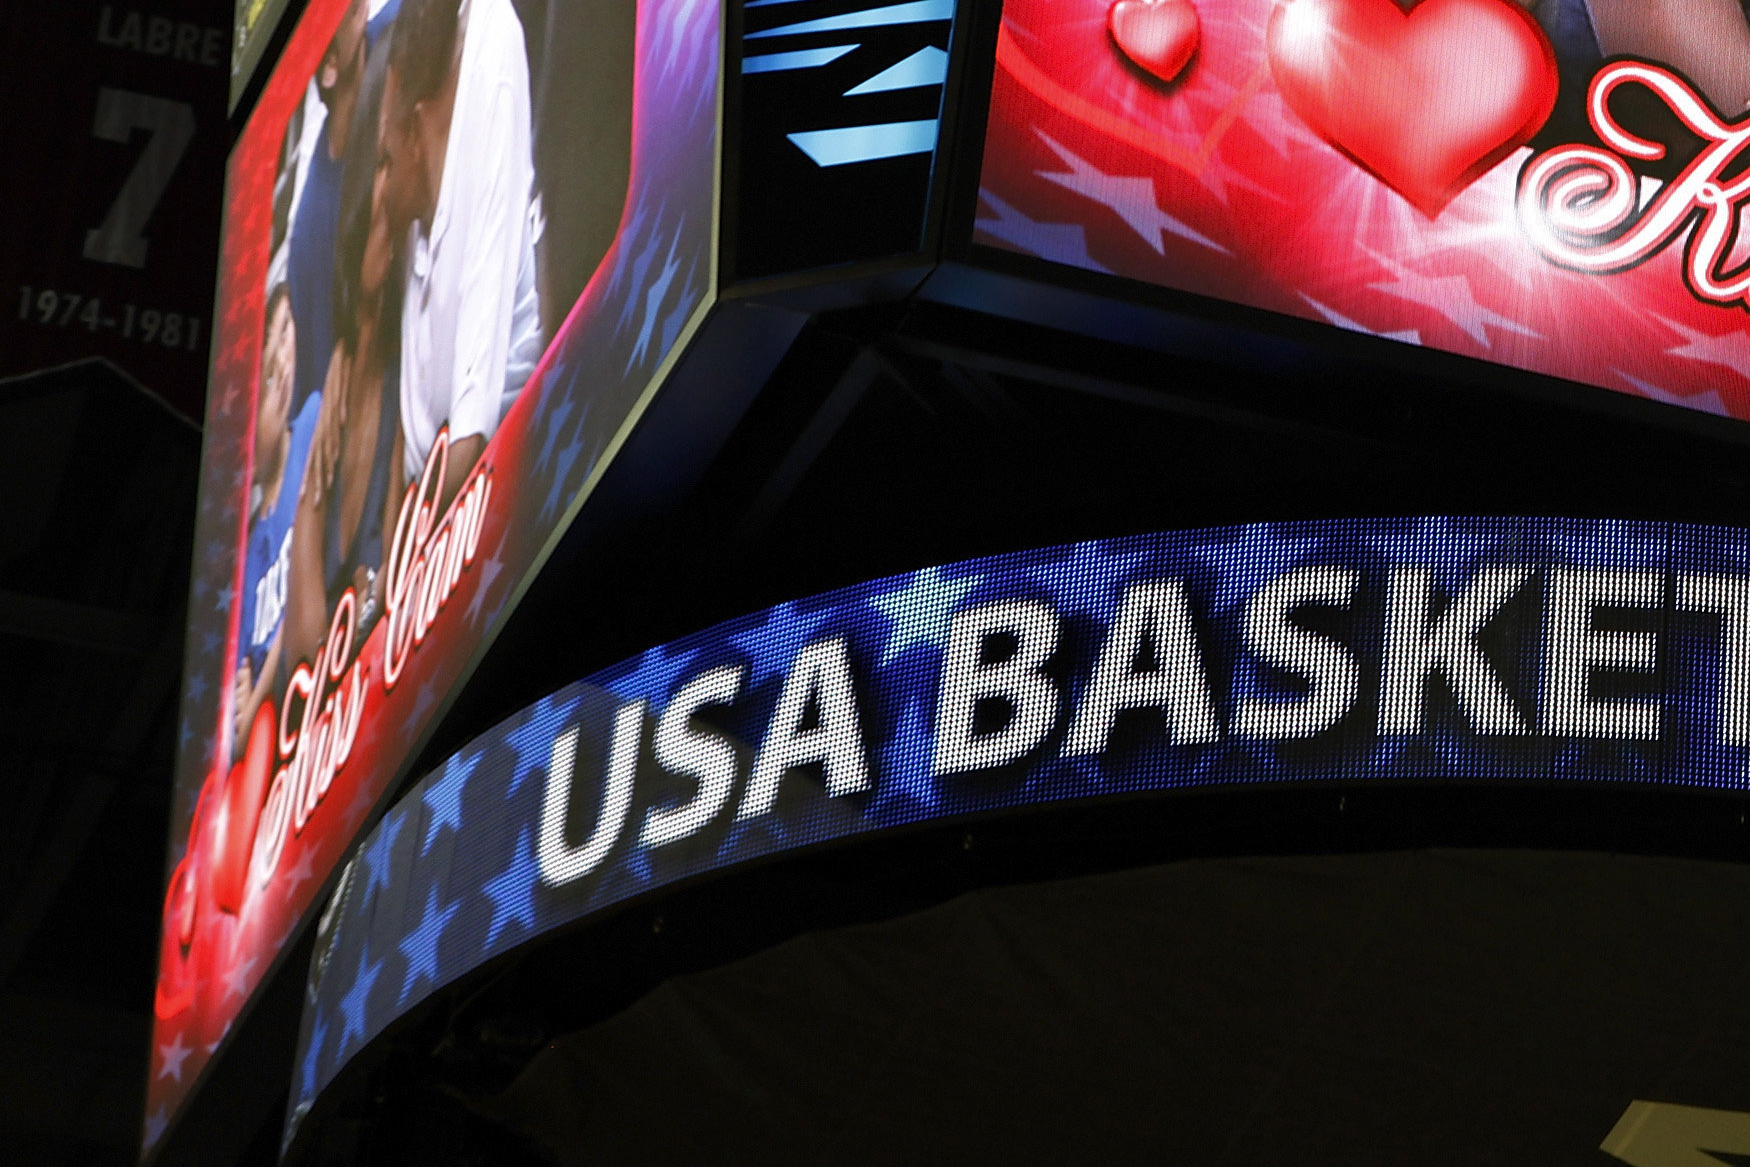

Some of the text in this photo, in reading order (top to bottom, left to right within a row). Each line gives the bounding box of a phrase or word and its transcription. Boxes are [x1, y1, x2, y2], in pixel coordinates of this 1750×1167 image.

[99, 5, 222, 67] LABRE
[82, 86, 197, 270] 7
[19, 286, 201, 350] 1974-1981
[537, 634, 873, 888] USA
